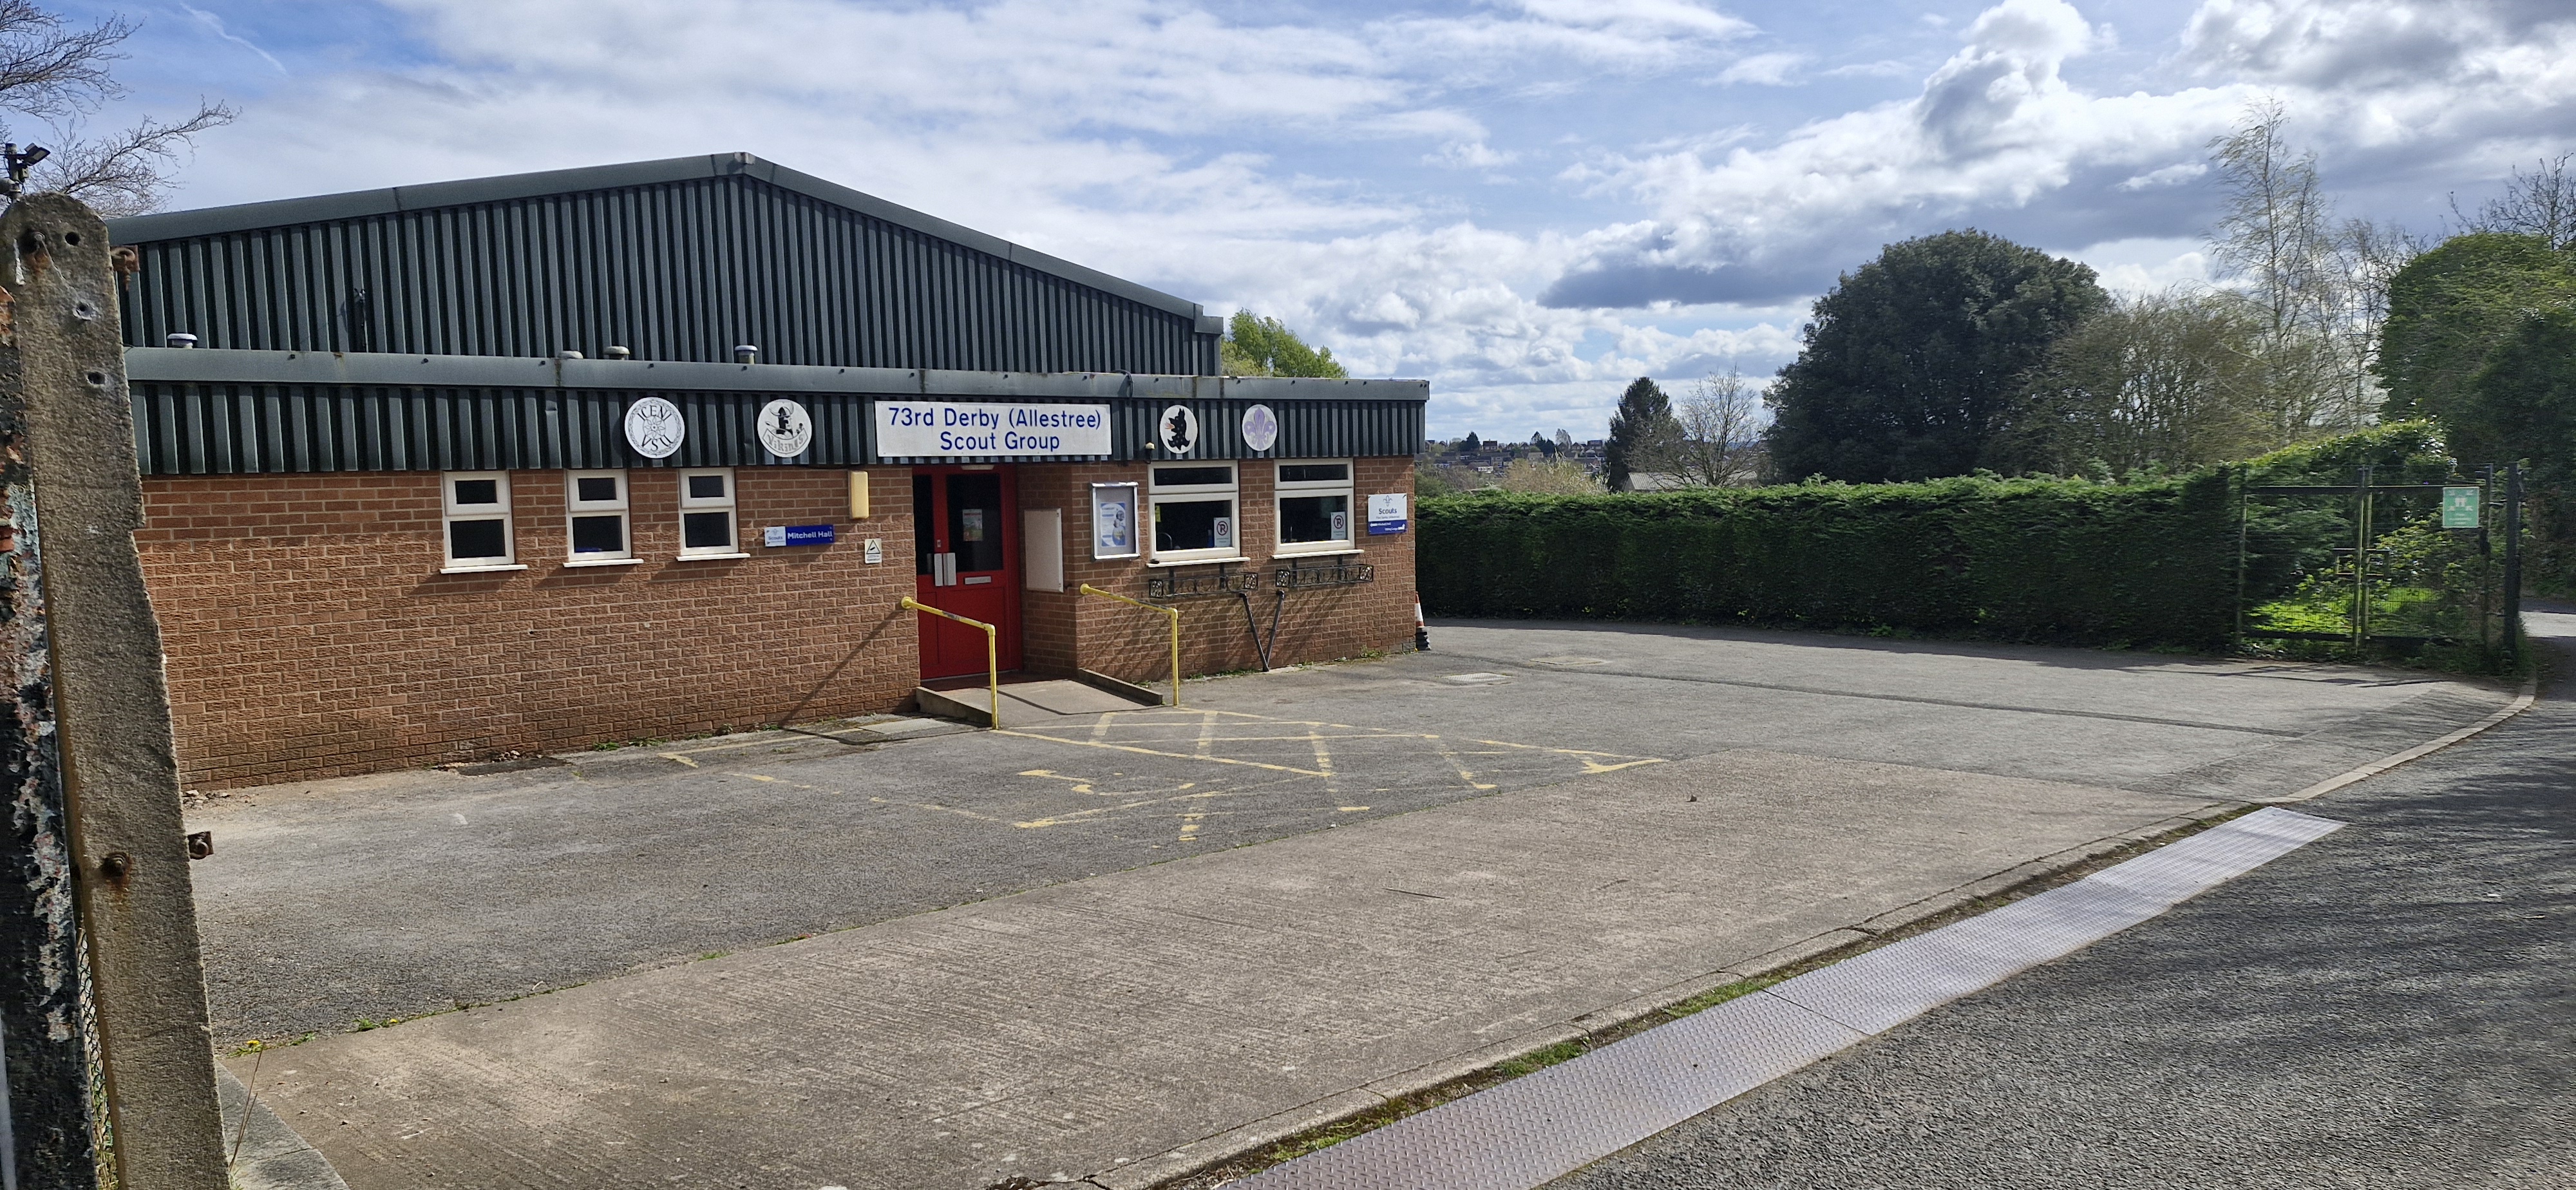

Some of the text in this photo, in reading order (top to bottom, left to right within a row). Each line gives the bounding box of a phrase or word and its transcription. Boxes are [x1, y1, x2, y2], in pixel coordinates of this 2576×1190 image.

[888, 407, 1101, 430] 73rd Derby (Allestree)
[767, 434, 804, 452] Vikings
[940, 431, 1060, 451] Scout Group
